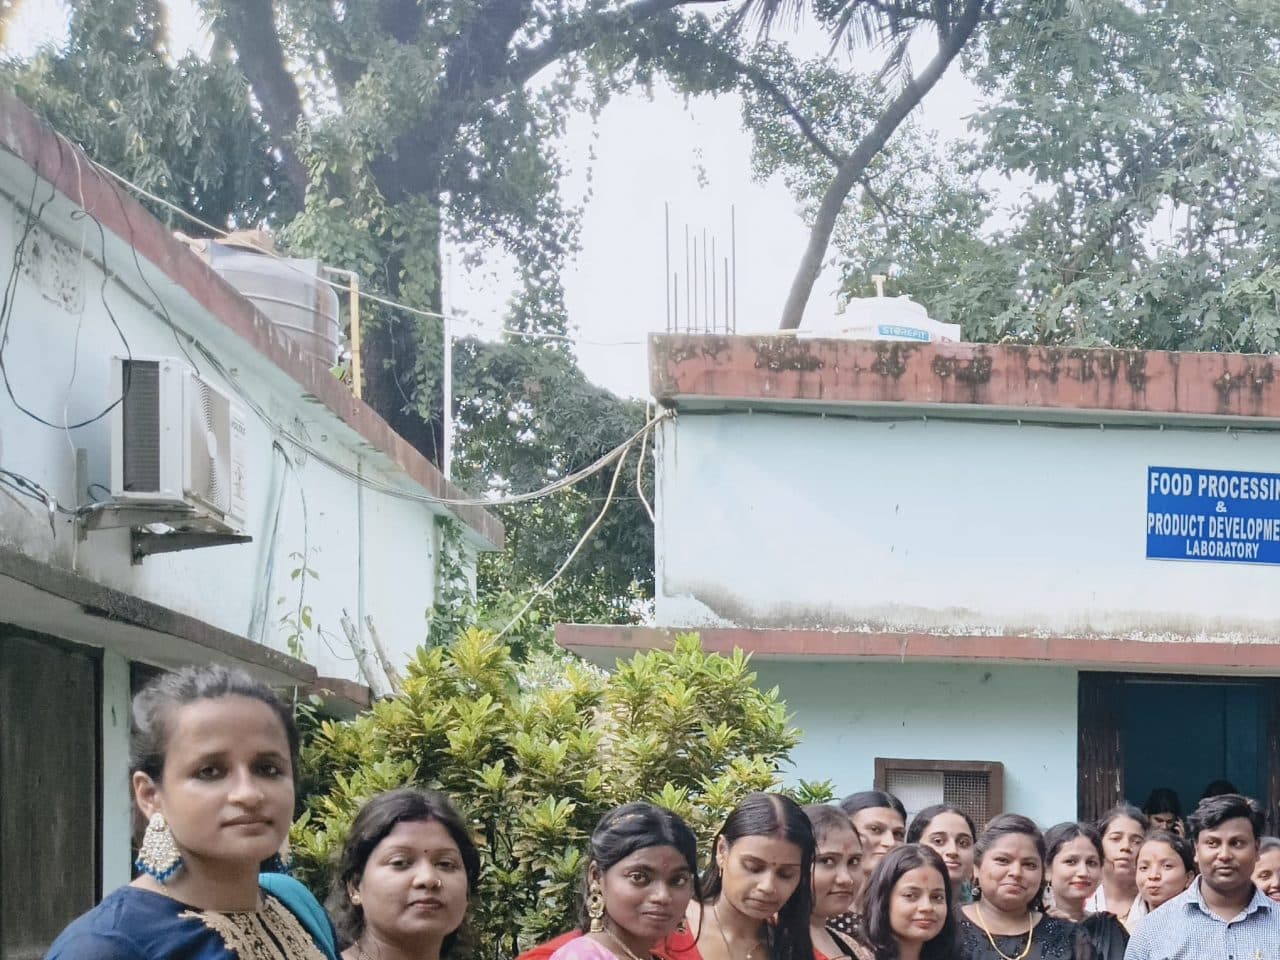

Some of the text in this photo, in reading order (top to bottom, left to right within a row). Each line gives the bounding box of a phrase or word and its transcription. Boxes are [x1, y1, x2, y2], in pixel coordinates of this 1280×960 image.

[1151, 472, 1192, 496] FOOD
[1215, 501, 1227, 512] &
[1148, 513, 1205, 537] PRODUCT
[1186, 539, 1259, 558] LABORATORY
